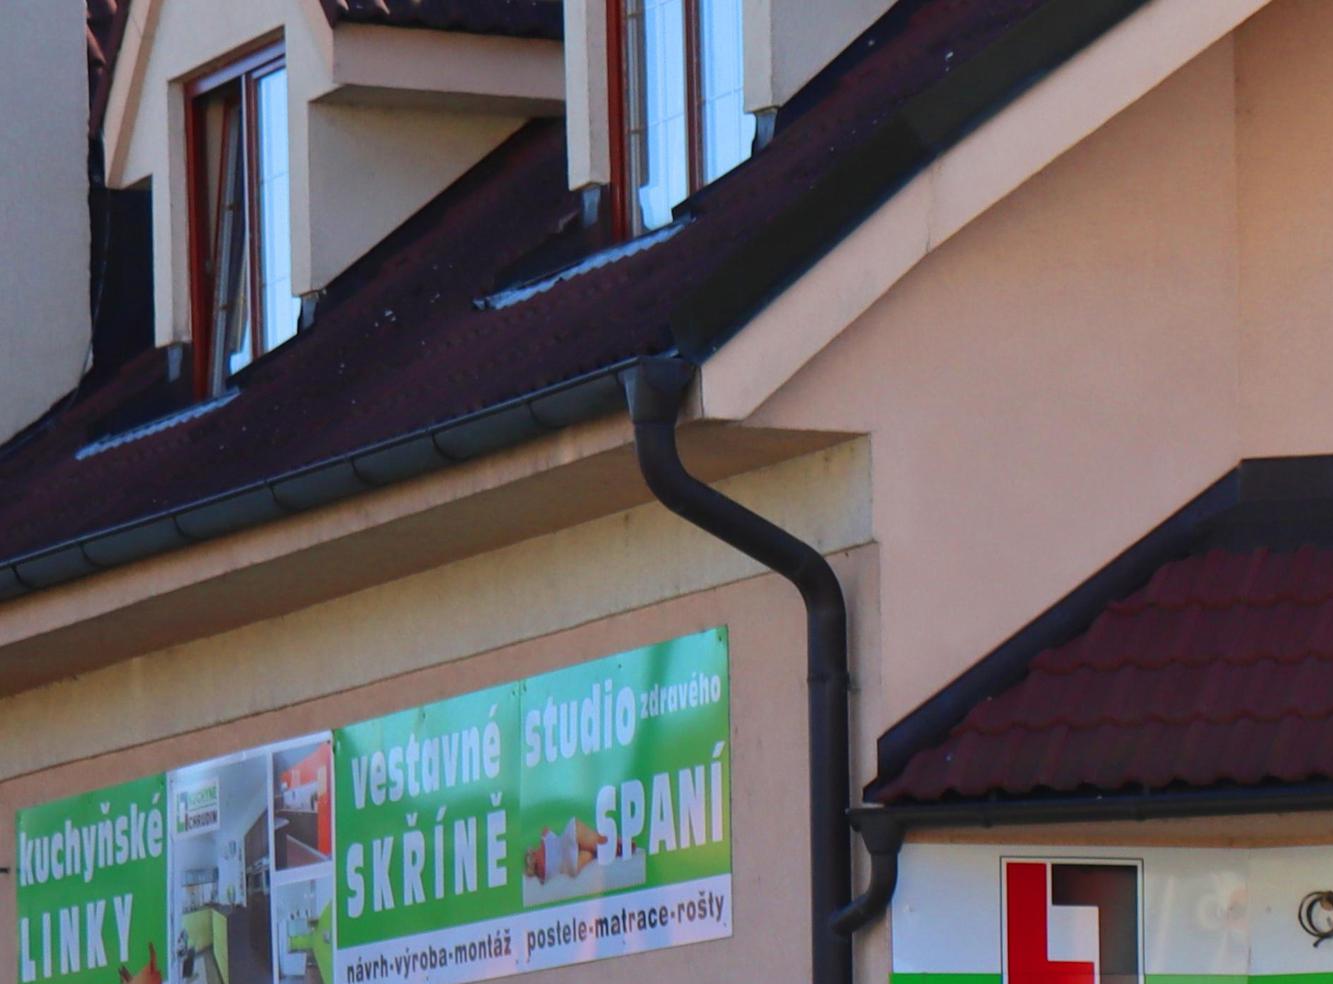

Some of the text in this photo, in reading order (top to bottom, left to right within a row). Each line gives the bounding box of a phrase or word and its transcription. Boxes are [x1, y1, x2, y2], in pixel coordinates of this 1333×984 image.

[351, 704, 501, 810] vestavné
[525, 672, 721, 768] studio zdravého
[19, 793, 163, 887] kuchyňské
[595, 741, 725, 866] SPANÍ
[345, 792, 508, 918] SKŘÍNĚ
[21, 893, 133, 983] LINKY
